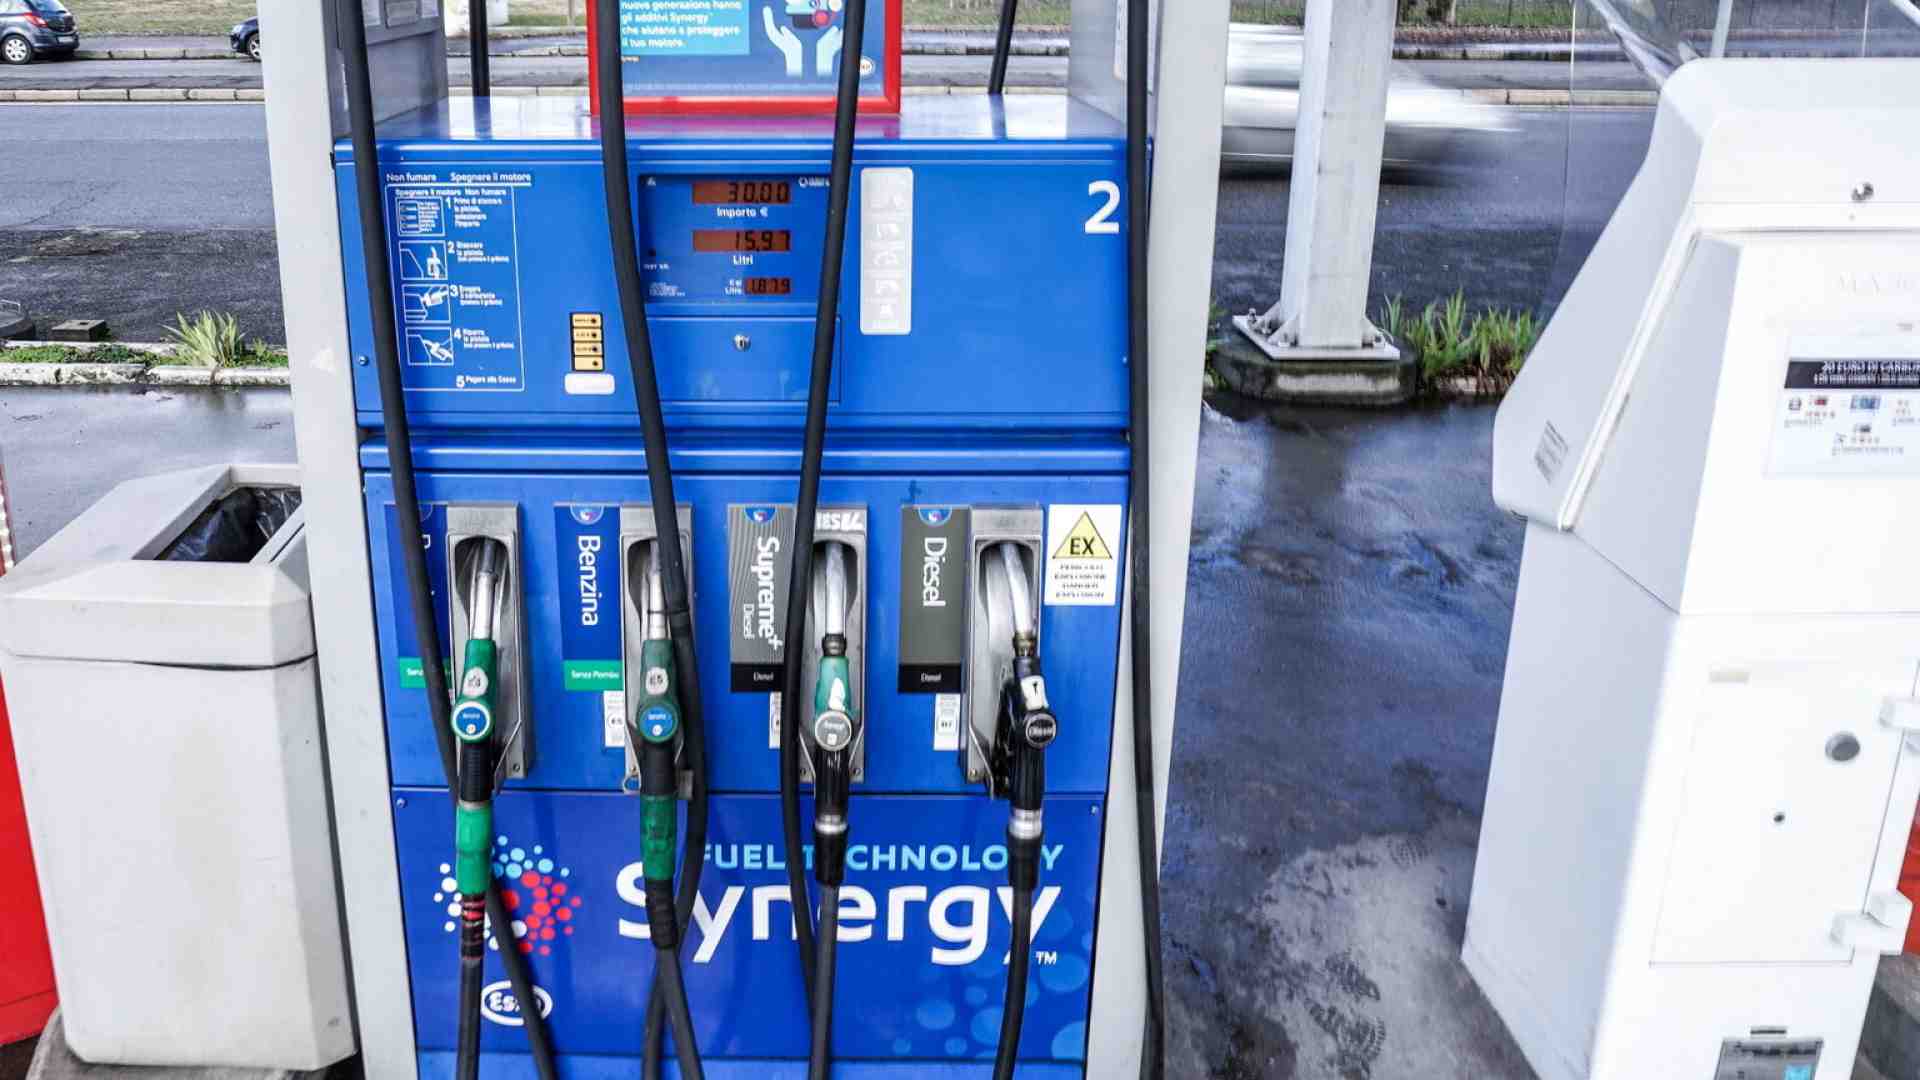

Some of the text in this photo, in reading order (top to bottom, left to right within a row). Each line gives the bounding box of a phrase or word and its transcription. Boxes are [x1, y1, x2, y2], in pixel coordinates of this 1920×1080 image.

[622, 26, 639, 35] che
[641, 26, 677, 35] aiutano
[687, 26, 740, 38] proteggere
[630, 38, 647, 48] tuo
[386, 174, 404, 182] Non
[406, 172, 437, 182] fumare
[450, 172, 491, 185] Spegnere
[500, 173, 532, 182] motore
[727, 181, 789, 204] 30.00
[446, 197, 451, 208] 1
[1085, 180, 1121, 234] 2
[716, 207, 757, 218] Importo
[448, 241, 456, 254] 2
[735, 231, 791, 252] 15.97
[733, 255, 754, 266] Litri
[450, 284, 459, 297] 3
[453, 327, 462, 339] 4
[456, 375, 465, 388] 5
[1069, 536, 1096, 556] EX
[923, 537, 947, 607] Diesel
[577, 535, 602, 626] Benzina
[743, 603, 755, 640] Diesel
[802, 844, 1064, 871] TCHNOLOY
